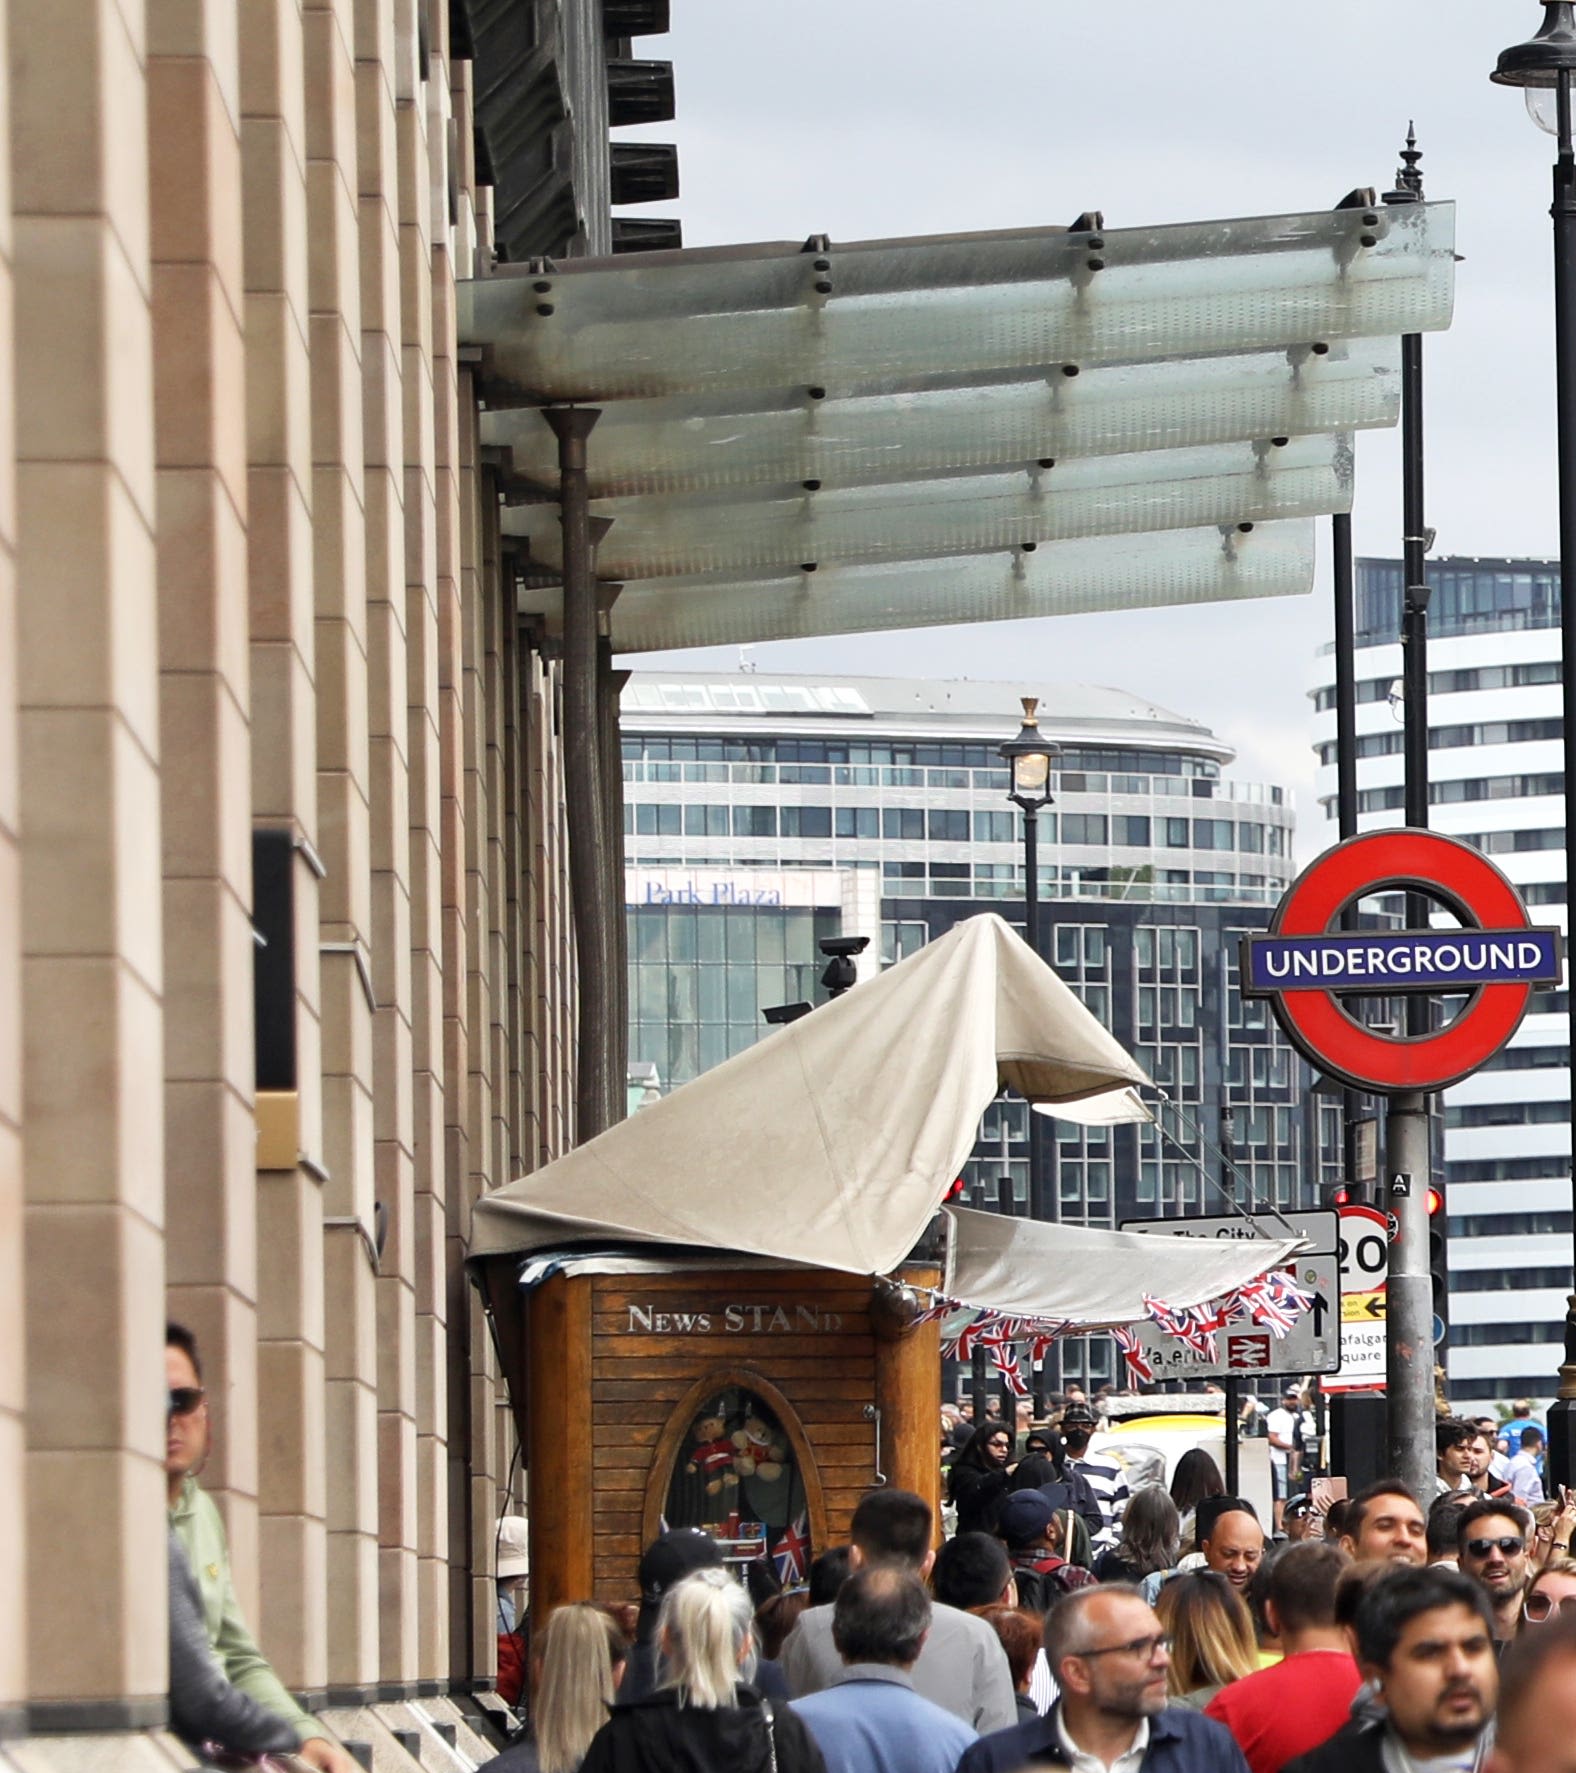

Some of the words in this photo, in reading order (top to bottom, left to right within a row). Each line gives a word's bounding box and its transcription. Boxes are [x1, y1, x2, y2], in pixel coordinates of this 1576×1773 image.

[645, 881, 704, 904] Park
[712, 882, 781, 905] Plaza
[1265, 942, 1543, 977] UNDERGROUND
[1341, 1352, 1381, 1363] quare
